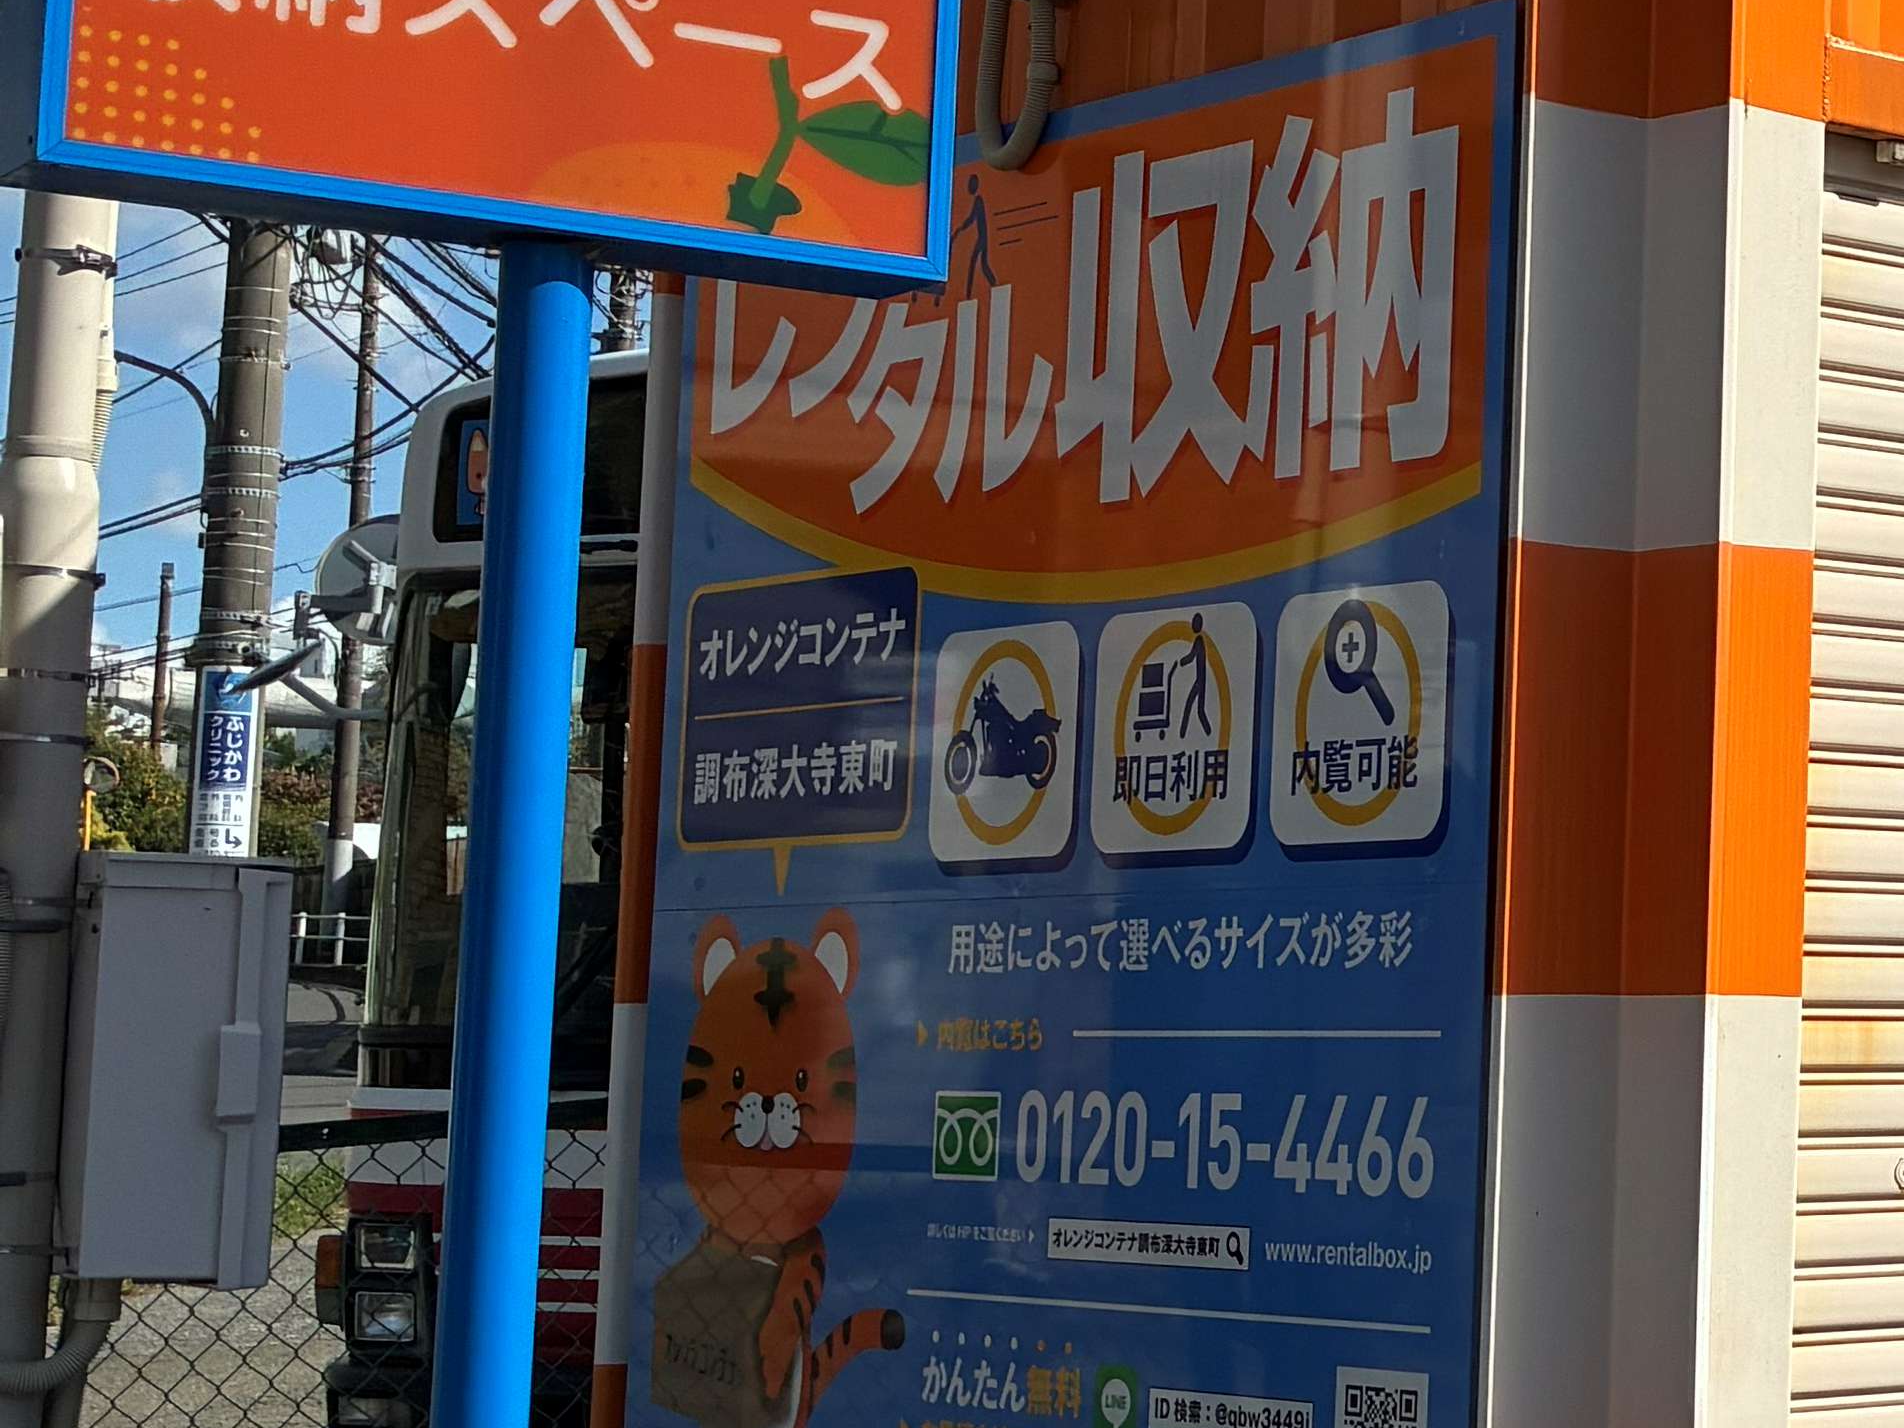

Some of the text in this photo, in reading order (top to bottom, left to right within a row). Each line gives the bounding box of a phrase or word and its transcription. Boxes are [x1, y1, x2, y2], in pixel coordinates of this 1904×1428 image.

[699, 607, 907, 683] オレンジコンテナ
[207, 715, 224, 781] クリニック
[222, 715, 245, 782] ふじかわ
[694, 738, 899, 806] 調布深大寺東町
[1112, 750, 1231, 804] 即日利用
[1290, 735, 1419, 797] 内覧可能
[948, 910, 1415, 976] 用途によって選べるサイズが多彩
[1015, 1089, 1435, 1199] 0120-15-4466
[1053, 1227, 1220, 1258] オレンジコンテナ調布深大寺東町
[1264, 1241, 1432, 1274] www.rentalbox.jp
[921, 1355, 1082, 1420] かんたん無料
[1104, 1395, 1127, 1410] LINE
